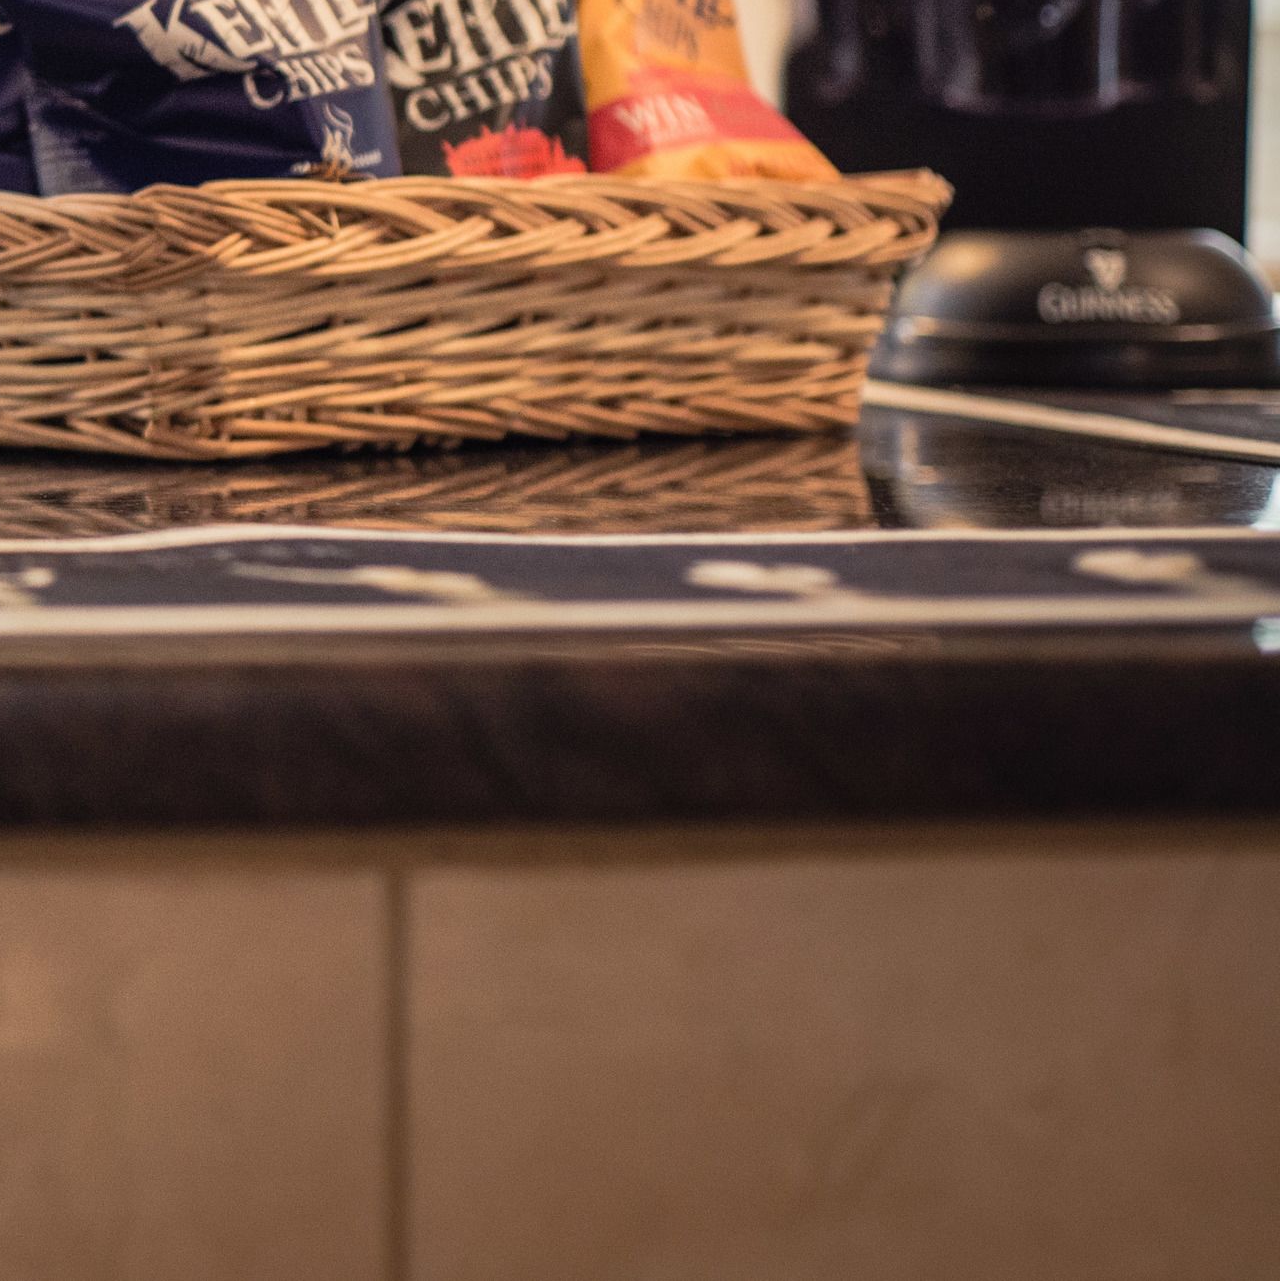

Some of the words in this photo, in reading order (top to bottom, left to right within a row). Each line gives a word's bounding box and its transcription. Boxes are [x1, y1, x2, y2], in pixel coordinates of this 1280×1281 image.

[243, 43, 376, 109] CHIPS
[406, 53, 554, 132] CHIPS
[1038, 281, 1182, 324] GUINNESS
